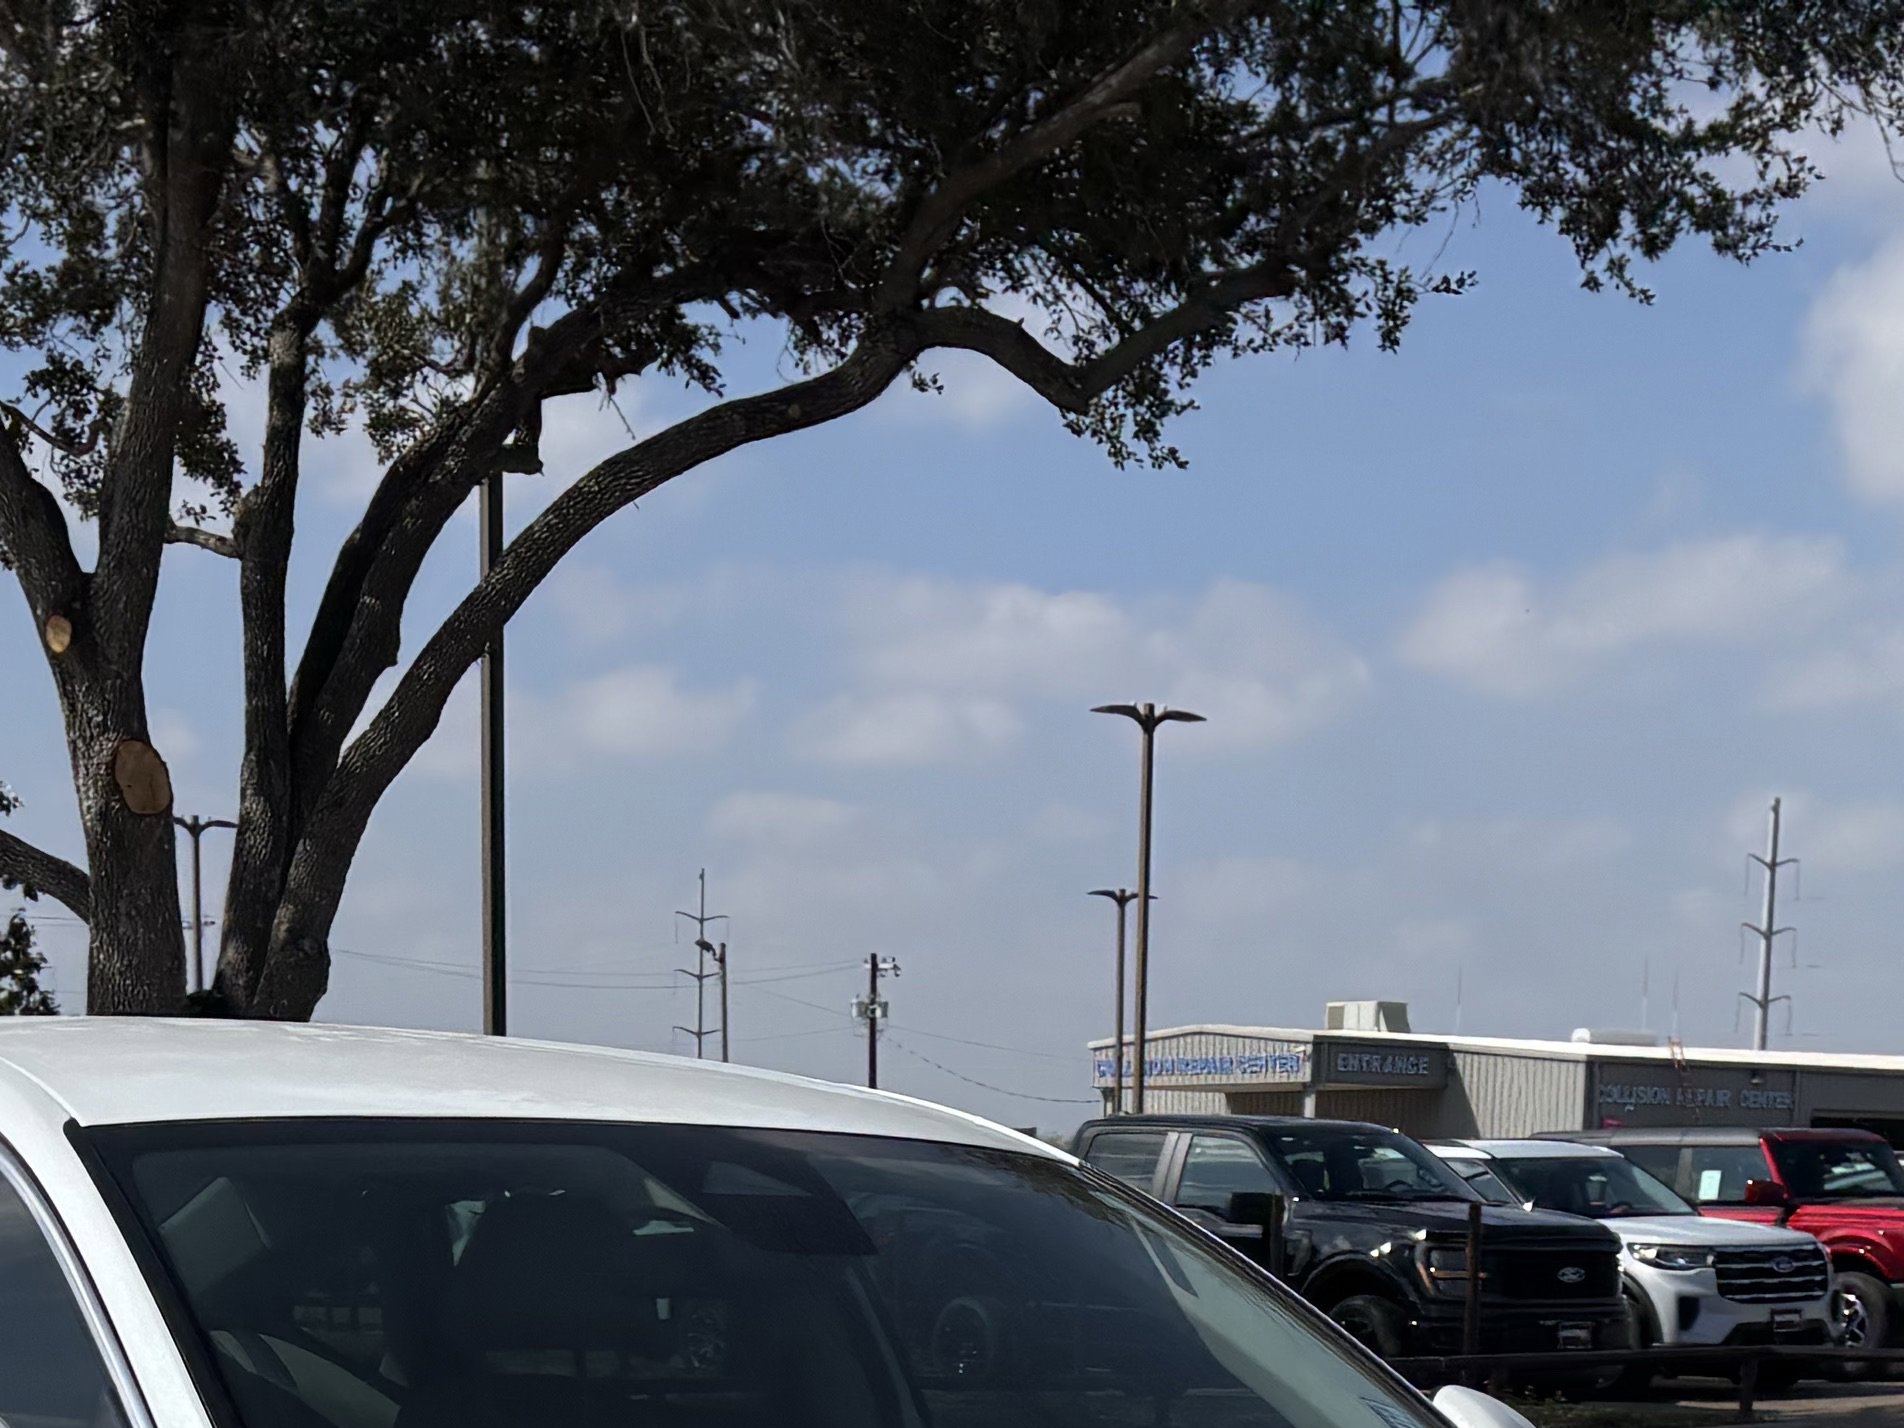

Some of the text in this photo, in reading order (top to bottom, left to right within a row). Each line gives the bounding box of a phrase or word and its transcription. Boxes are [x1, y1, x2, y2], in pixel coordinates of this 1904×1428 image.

[1096, 1058, 1175, 1077] COLION
[1337, 1053, 1430, 1074] ENTRANCE
[1599, 1083, 1670, 1105] COLLISION
[1740, 1088, 1794, 1109] CENTER
